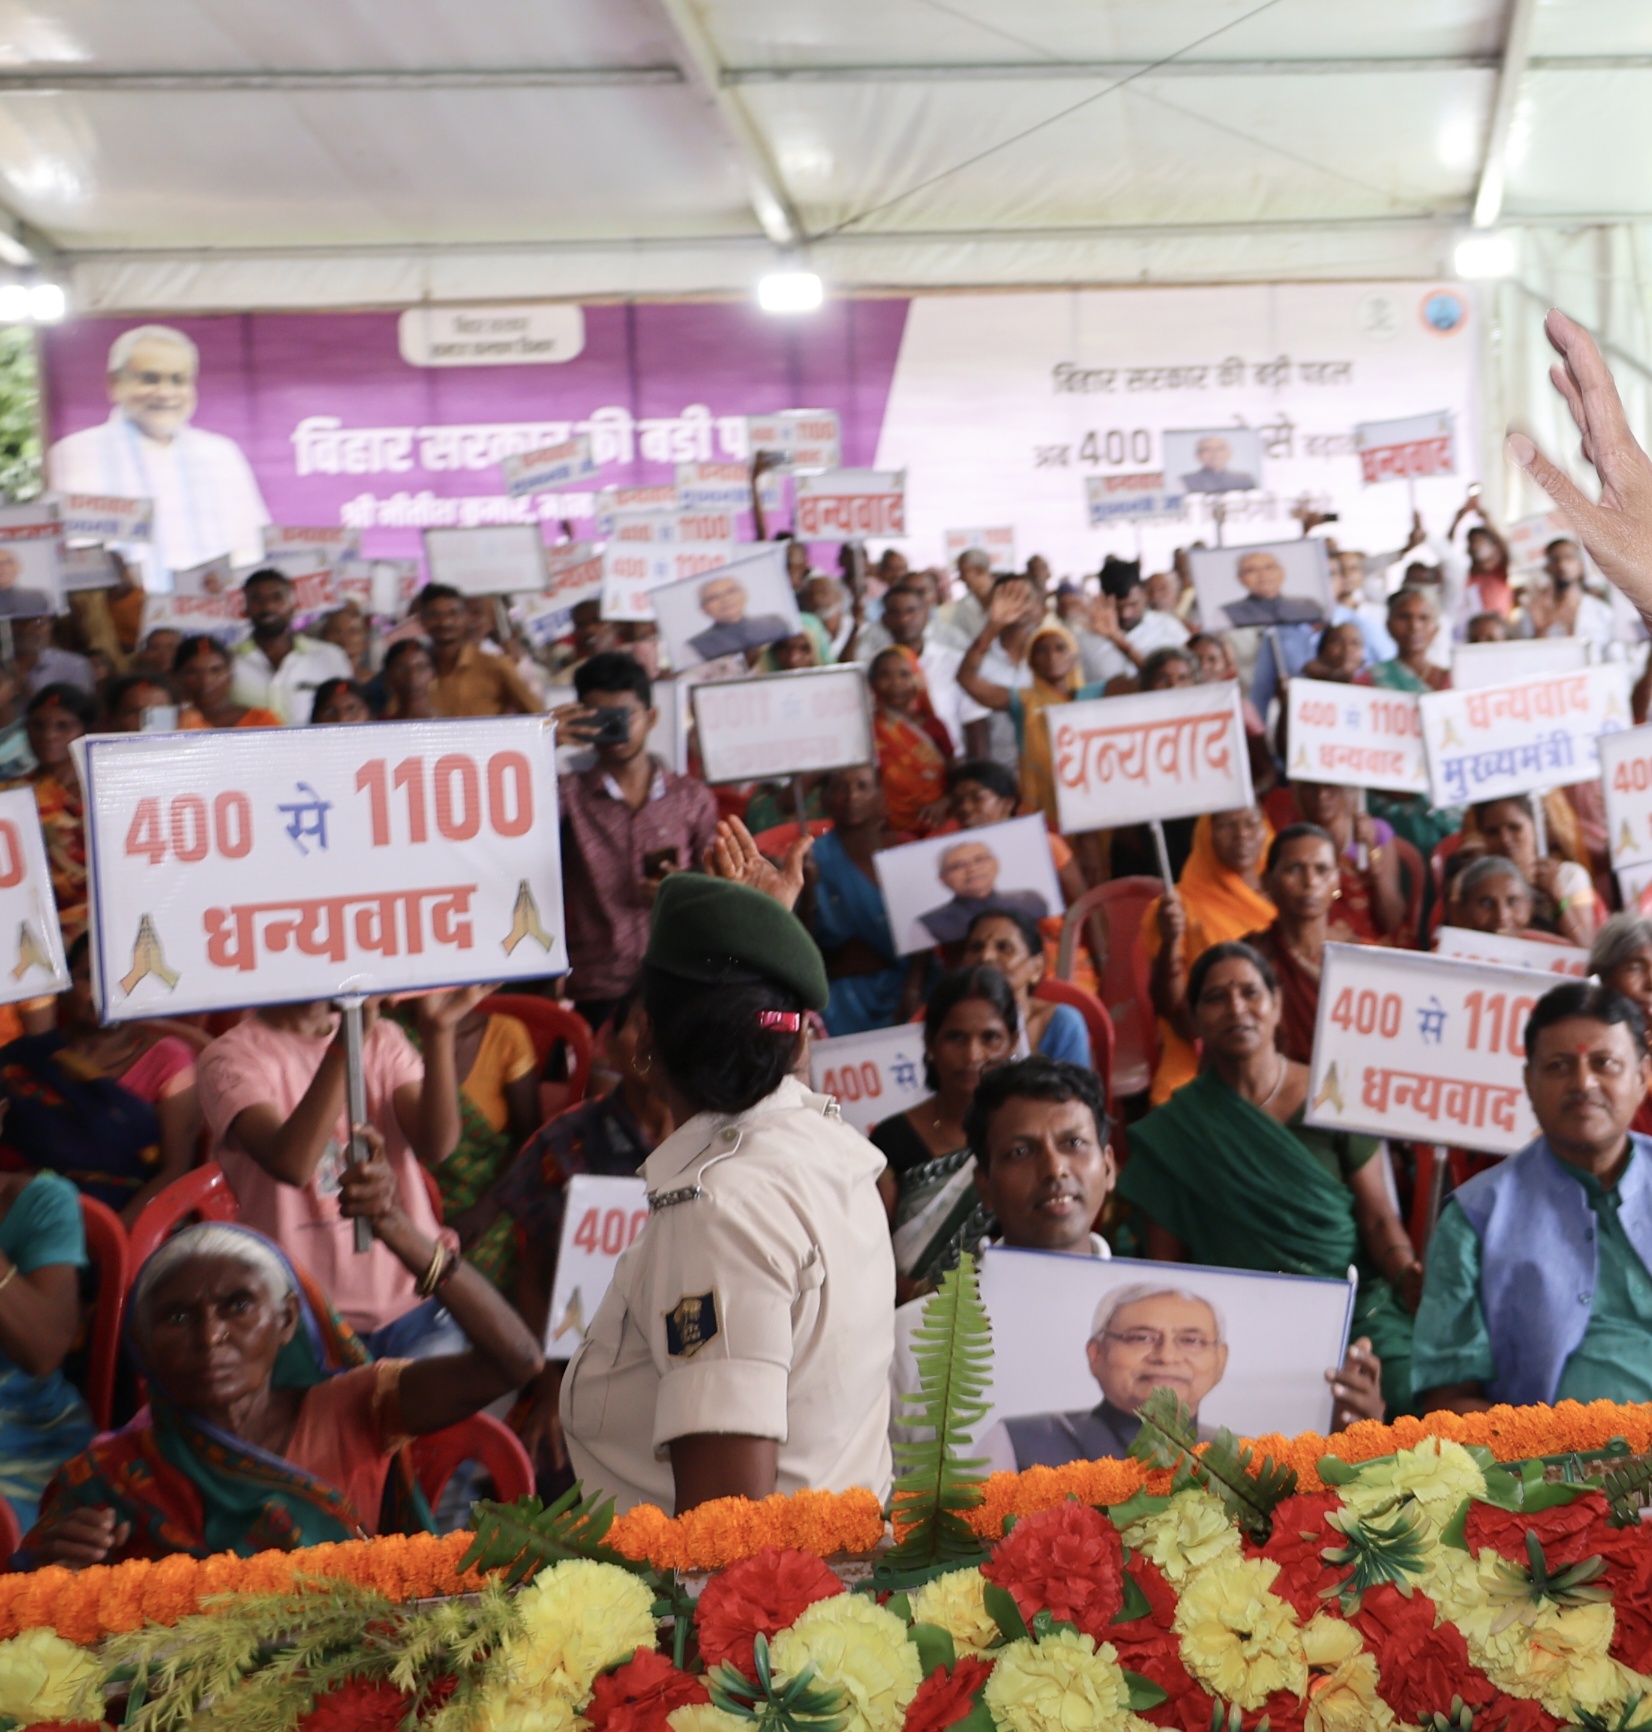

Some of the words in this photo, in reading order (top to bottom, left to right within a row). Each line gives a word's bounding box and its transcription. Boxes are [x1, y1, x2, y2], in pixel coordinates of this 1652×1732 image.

[290, 415, 414, 476] बिहार
[1079, 429, 1151, 465] 400
[1297, 702, 1337, 727] 400
[1465, 674, 1592, 730] धन्यवाद
[1056, 710, 1234, 797] धन्यवाद
[1318, 743, 1405, 777] धन्यवाद
[1441, 728, 1575, 801] मुख्यमंत्री
[124, 790, 254, 866] 400
[277, 782, 333, 855] से
[355, 750, 534, 847] 1100
[202, 884, 478, 972] धन्यवाद
[1331, 986, 1402, 1038] 400
[1415, 995, 1448, 1044] से
[1463, 990, 1536, 1057] 110
[823, 1060, 881, 1103] 400
[889, 1053, 918, 1092] से
[1361, 1065, 1521, 1132] धन्यवाद
